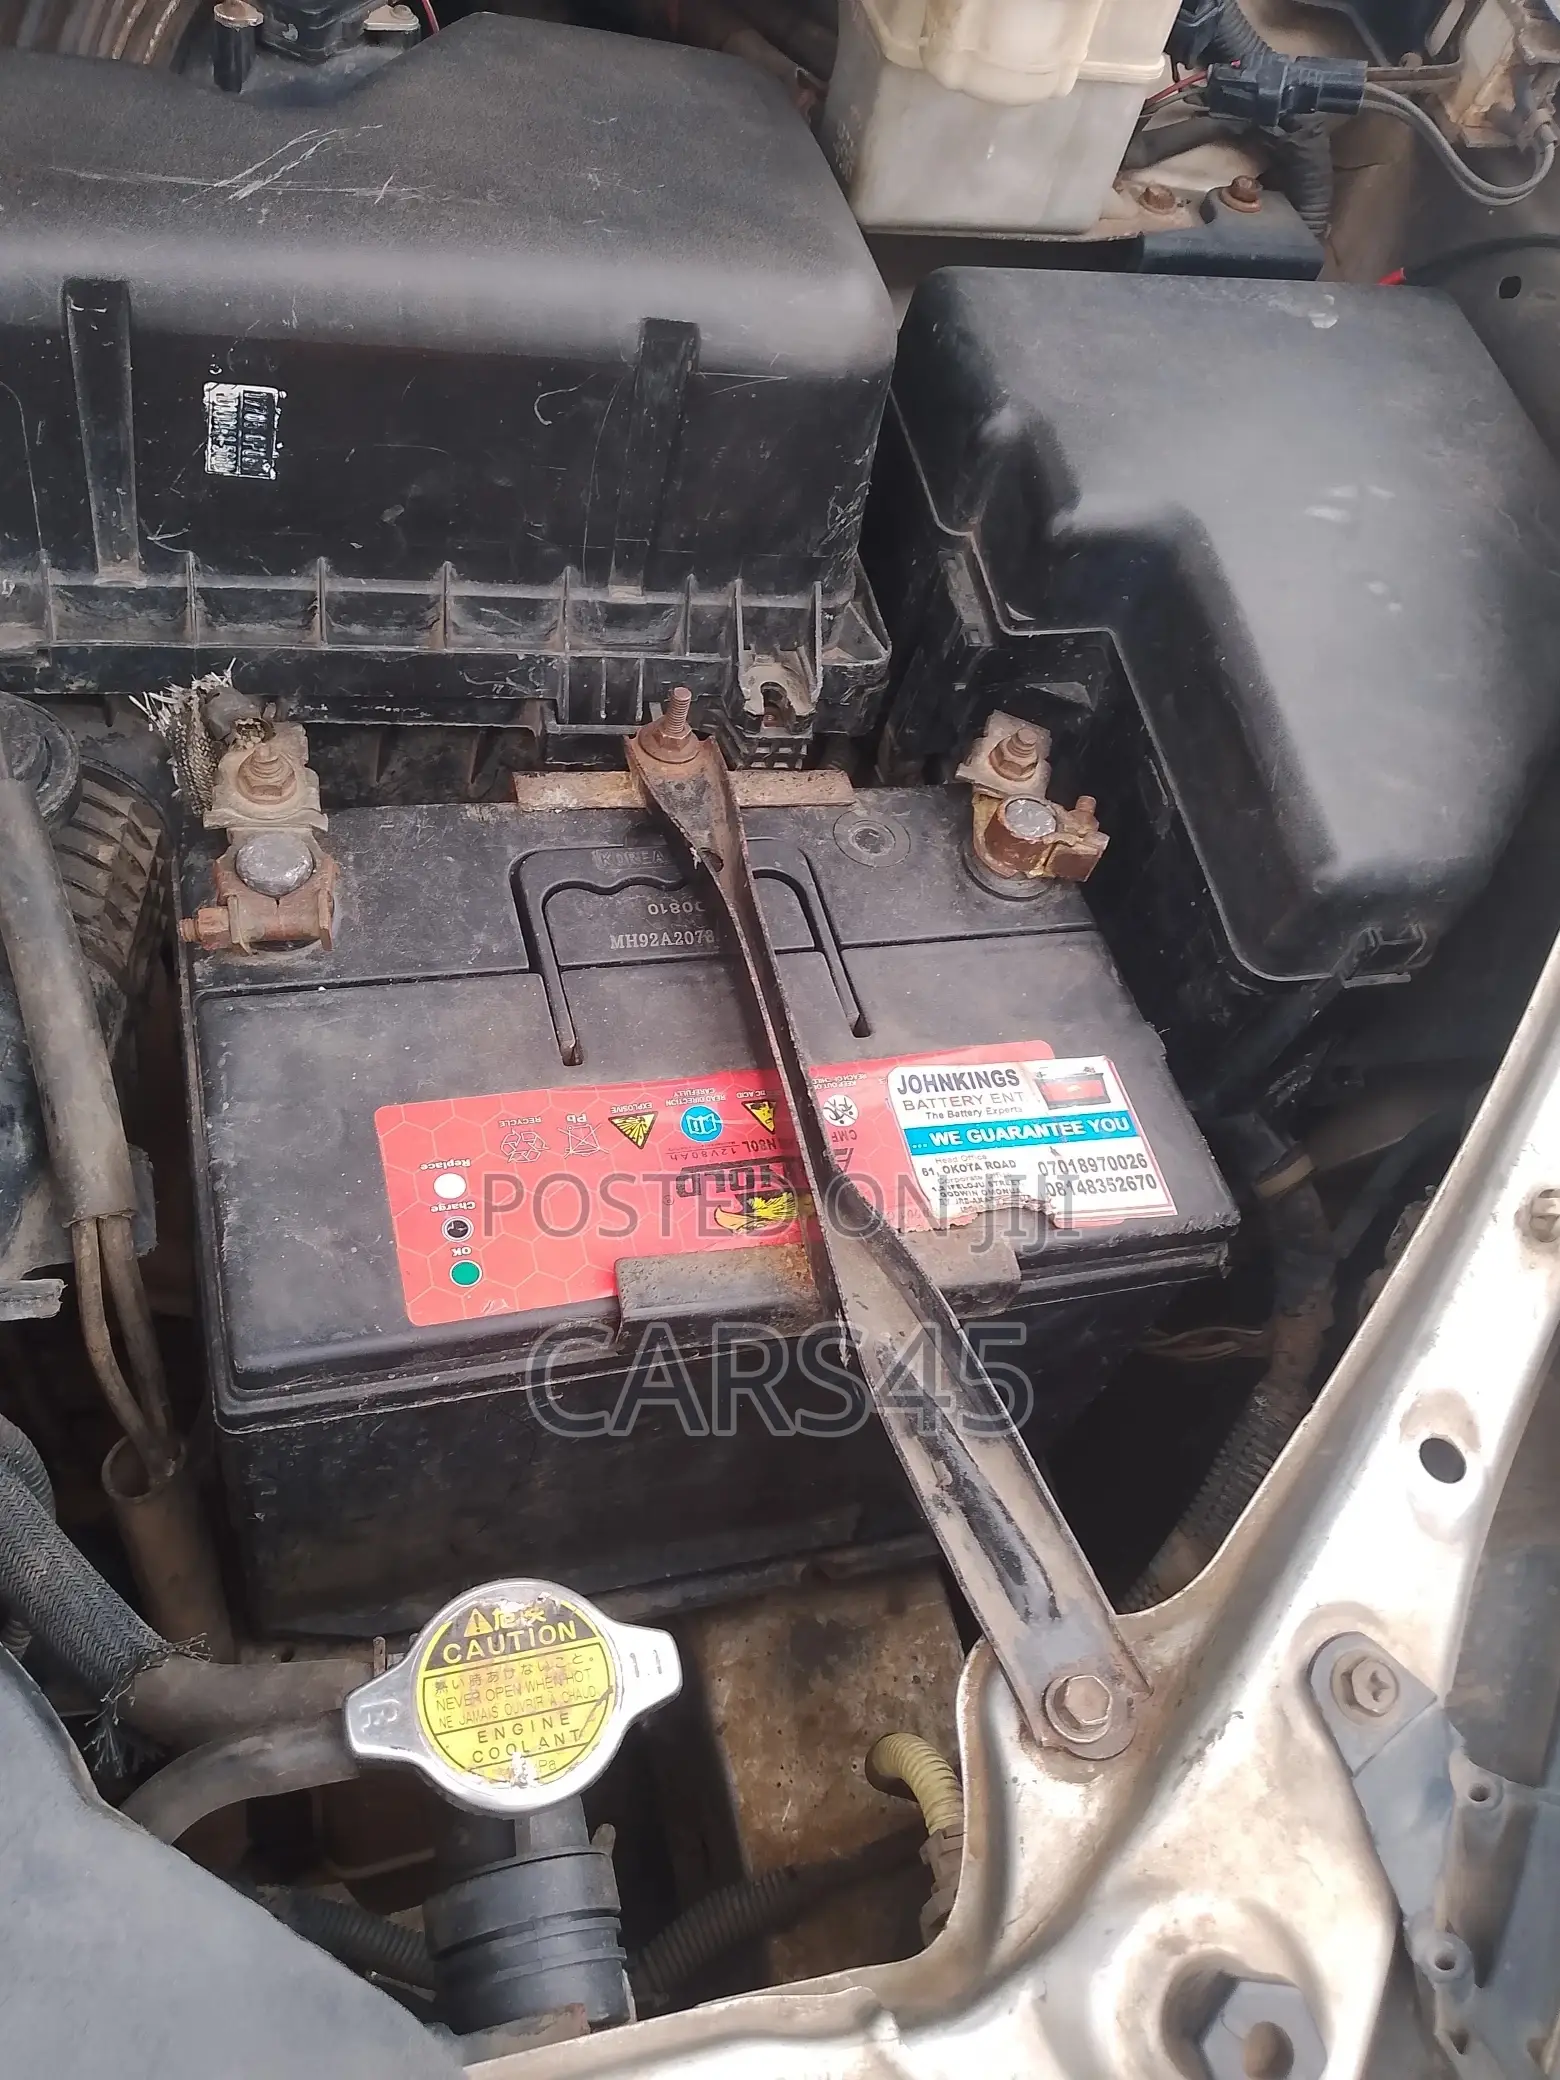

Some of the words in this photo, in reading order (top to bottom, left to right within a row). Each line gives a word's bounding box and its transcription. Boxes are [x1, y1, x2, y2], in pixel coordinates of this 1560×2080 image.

[897, 1069, 1020, 1095] JOHNKINGS
[665, 1095, 706, 1107] DIRECTION
[674, 1088, 715, 1098] CAREFULLY
[706, 1093, 726, 1103] READ
[611, 1101, 653, 1114] EXPLOSIVE
[902, 1094, 983, 1111] BATTERY
[567, 1113, 587, 1123] Pb
[926, 1111, 944, 1120] The
[947, 1108, 982, 1119] Battery
[986, 1106, 1023, 1116] Experts
[499, 1115, 542, 1128] RECYCLE
[928, 1130, 963, 1147] WE
[966, 1120, 1086, 1144] GUARANTEE
[1086, 1116, 1130, 1134] YOU
[420, 1159, 471, 1170] Replace
[942, 1162, 982, 1175] OKOTA
[985, 1159, 1016, 1170] ROAD
[1038, 1152, 1147, 1176] 07018970026
[1046, 1173, 1157, 1197] 08148352670
[430, 1201, 476, 1213] Charge
[451, 1246, 472, 1257] OK
[442, 1620, 577, 1664] CAUTION
[436, 1690, 482, 1711] NEVER
[485, 1682, 522, 1702] OPEN
[525, 1673, 564, 1693] WHEN
[565, 1667, 592, 1685] HOT
[438, 1715, 454, 1730] NE
[458, 1705, 499, 1726] JAMAIS
[504, 1694, 544, 1717] OUVRIR
[478, 1711, 571, 1744] ENGINE
[472, 1729, 582, 1763] COOLANT
